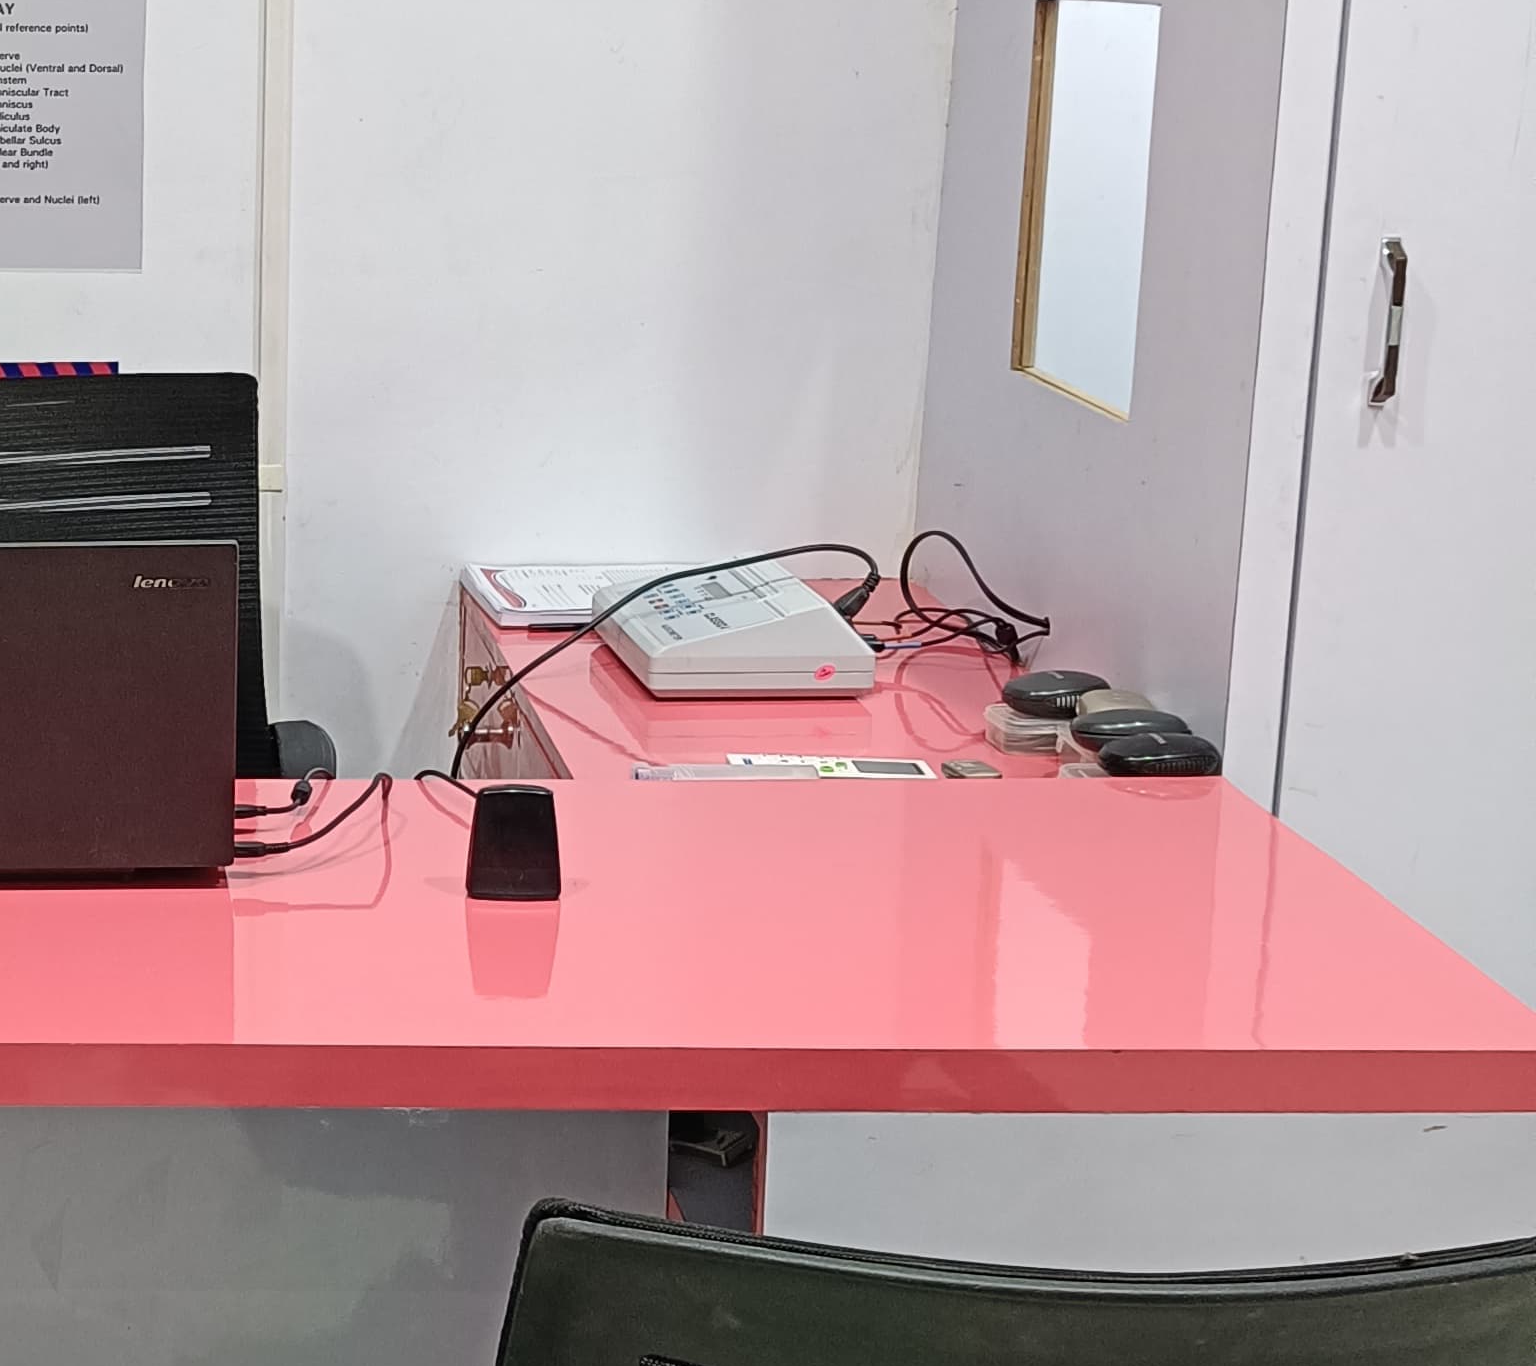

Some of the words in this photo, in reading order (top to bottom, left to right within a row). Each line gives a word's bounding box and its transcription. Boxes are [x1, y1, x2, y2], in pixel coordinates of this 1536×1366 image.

[6, 23, 52, 32] reference
[68, 63, 86, 73] and
[43, 87, 69, 97] Tract
[29, 136, 62, 145] Sulcus
[20, 148, 53, 157] Bundle
